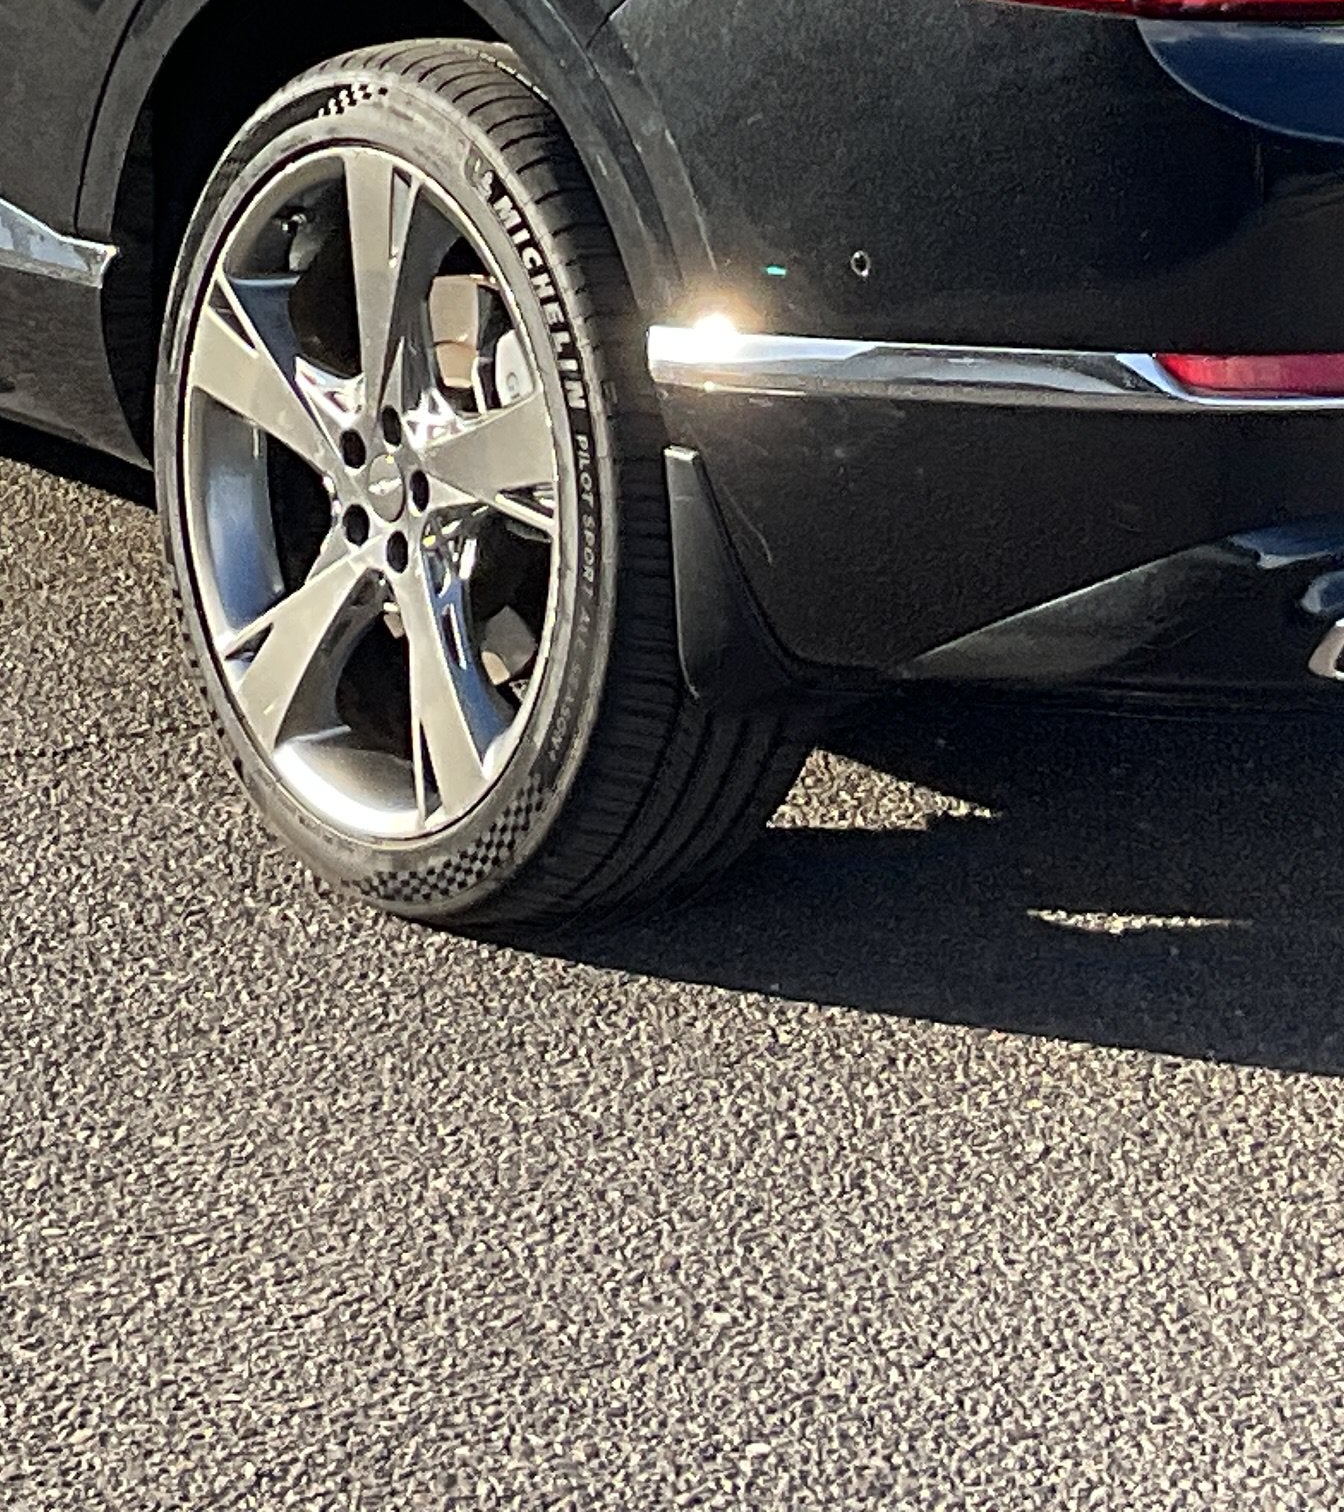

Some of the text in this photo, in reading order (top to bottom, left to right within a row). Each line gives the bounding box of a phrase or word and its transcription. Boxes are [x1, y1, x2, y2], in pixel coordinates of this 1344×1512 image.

[493, 194, 587, 409] MICHELIN
[576, 434, 596, 509] PILOT
[581, 513, 596, 598] SPORT
